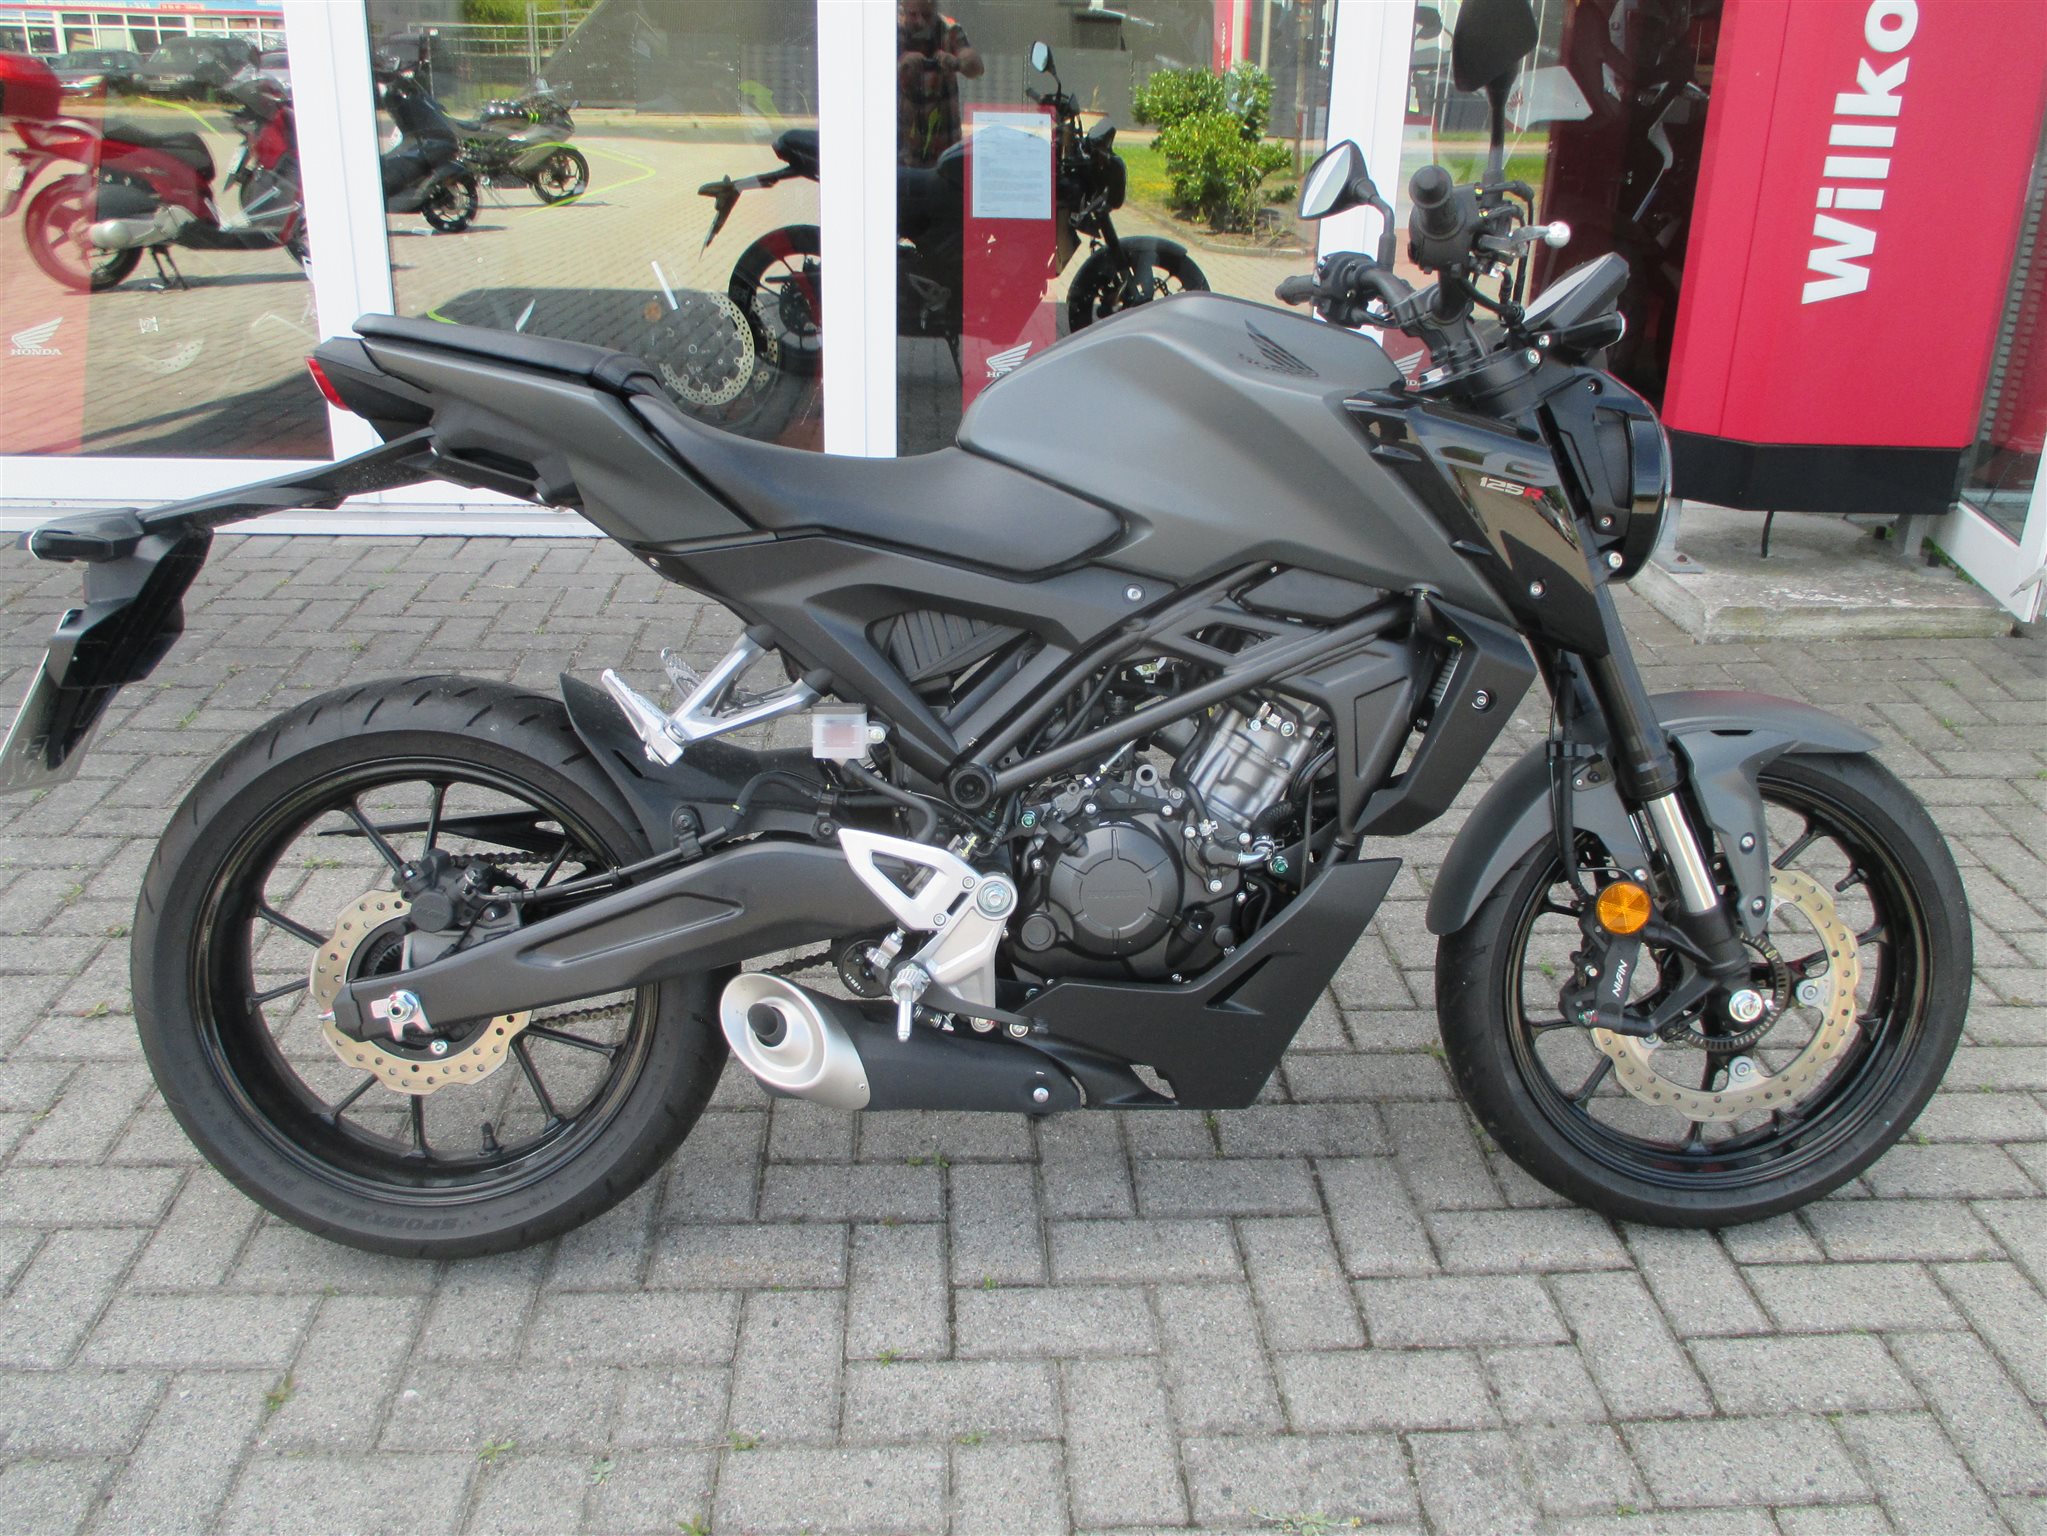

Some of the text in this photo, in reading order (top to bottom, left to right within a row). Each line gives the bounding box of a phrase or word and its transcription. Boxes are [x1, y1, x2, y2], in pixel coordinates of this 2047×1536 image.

[1801, 0, 1919, 305] Willko
[10, 348, 63, 356] HONDA
[1479, 476, 1545, 500] 125R
